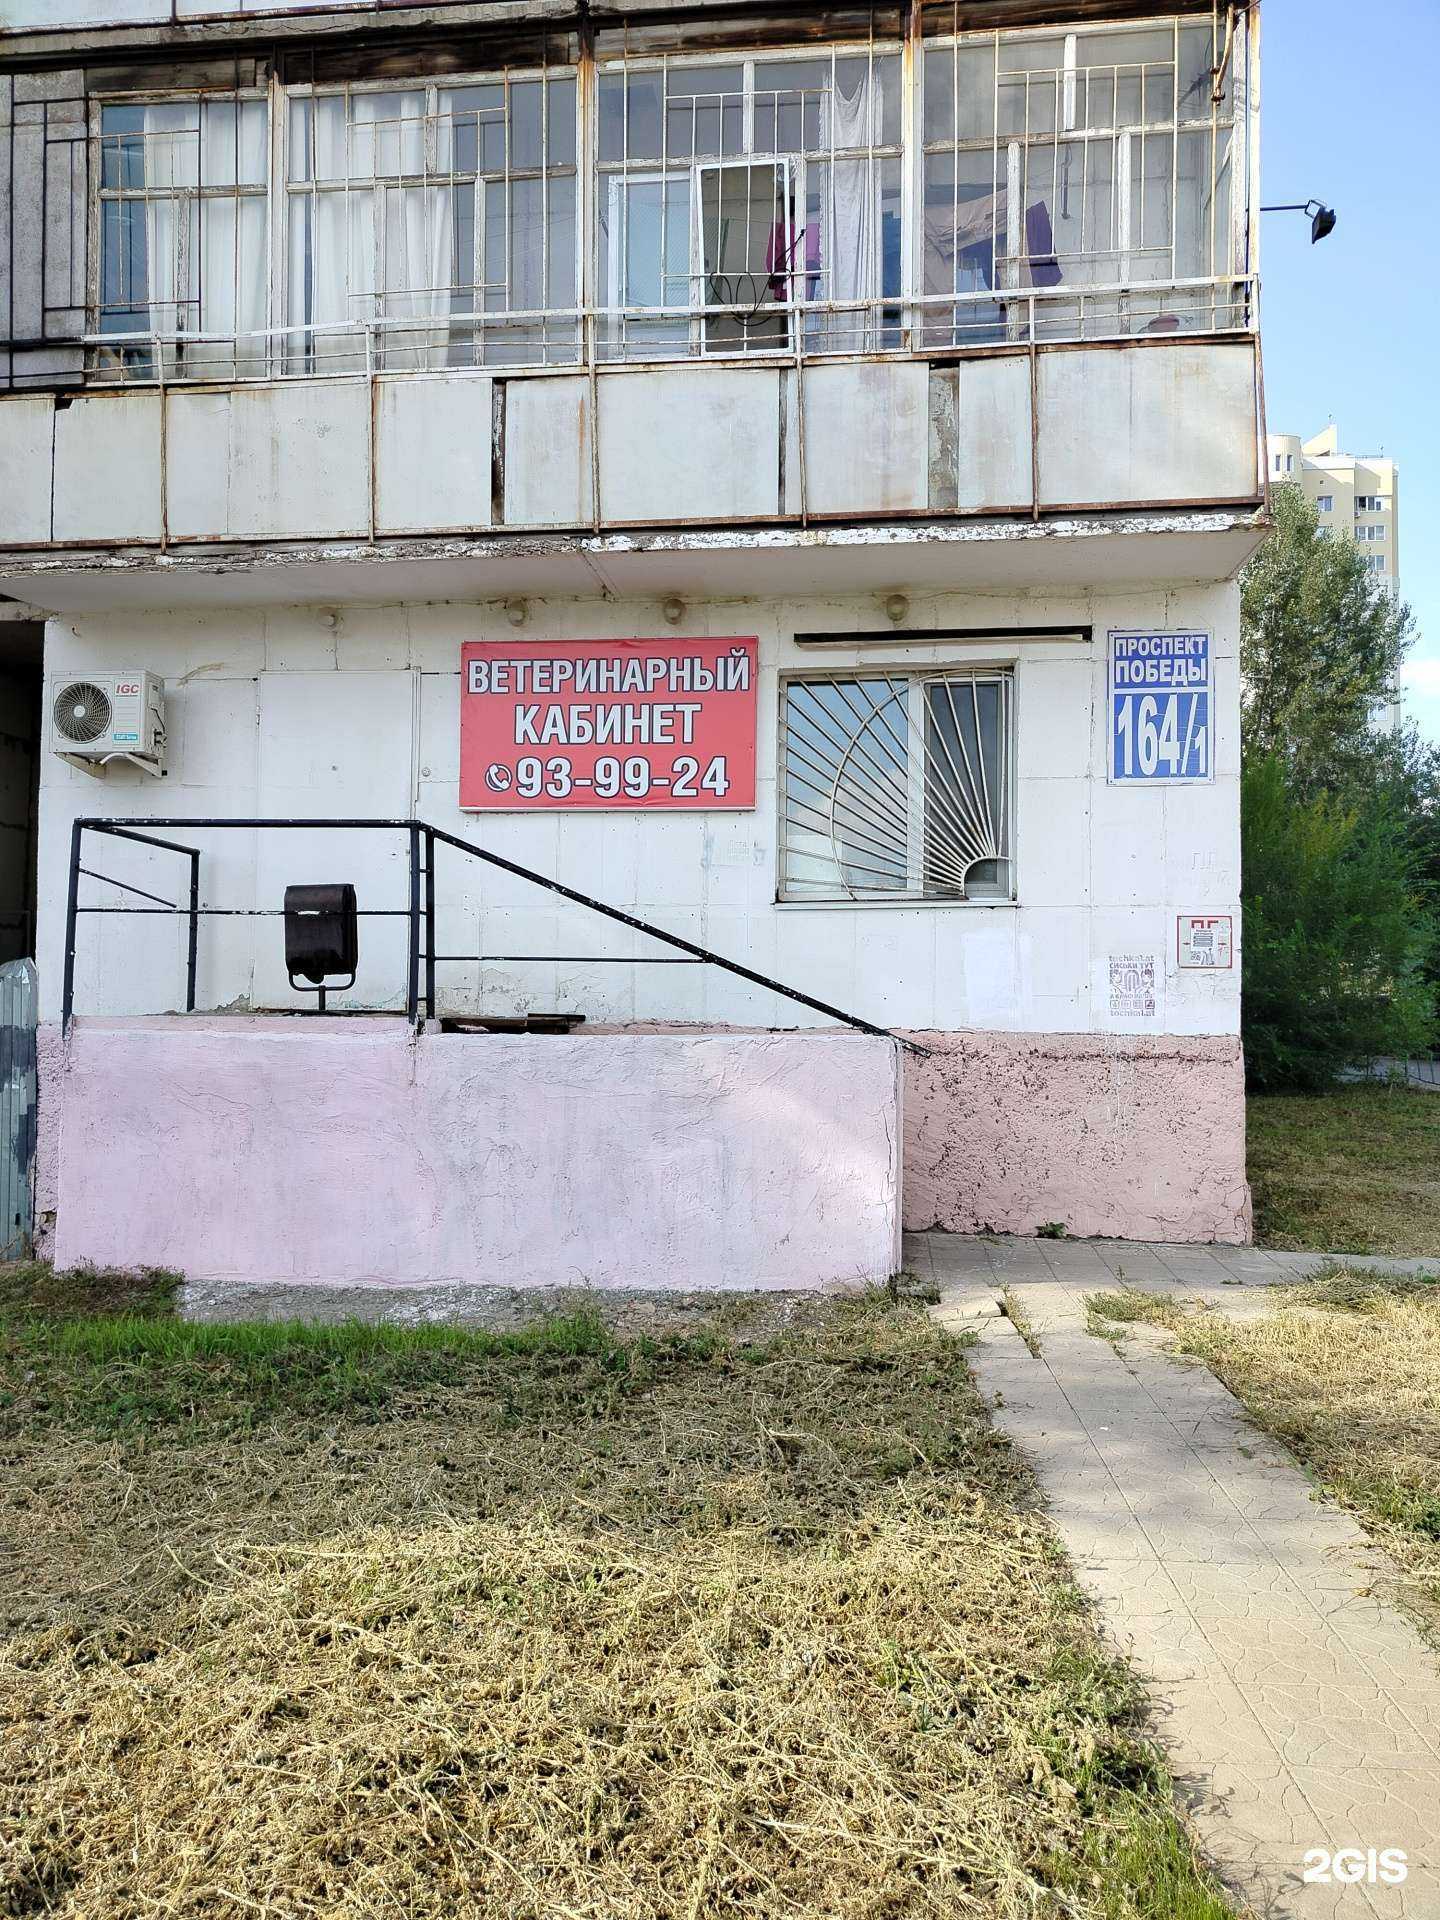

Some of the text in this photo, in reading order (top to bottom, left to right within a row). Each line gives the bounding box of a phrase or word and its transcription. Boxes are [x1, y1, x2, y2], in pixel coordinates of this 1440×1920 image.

[1115, 636, 1206, 657] ПРОСПЕКТ
[116, 684, 140, 694] IGC
[467, 648, 750, 695] ВЕТЕРИНАРНЫЙ
[1115, 658, 1206, 687] ПОБЕДЫ
[514, 703, 702, 745] КАБИНЕТ
[1117, 693, 1206, 776] 164/1
[516, 755, 729, 798] 93-99-24
